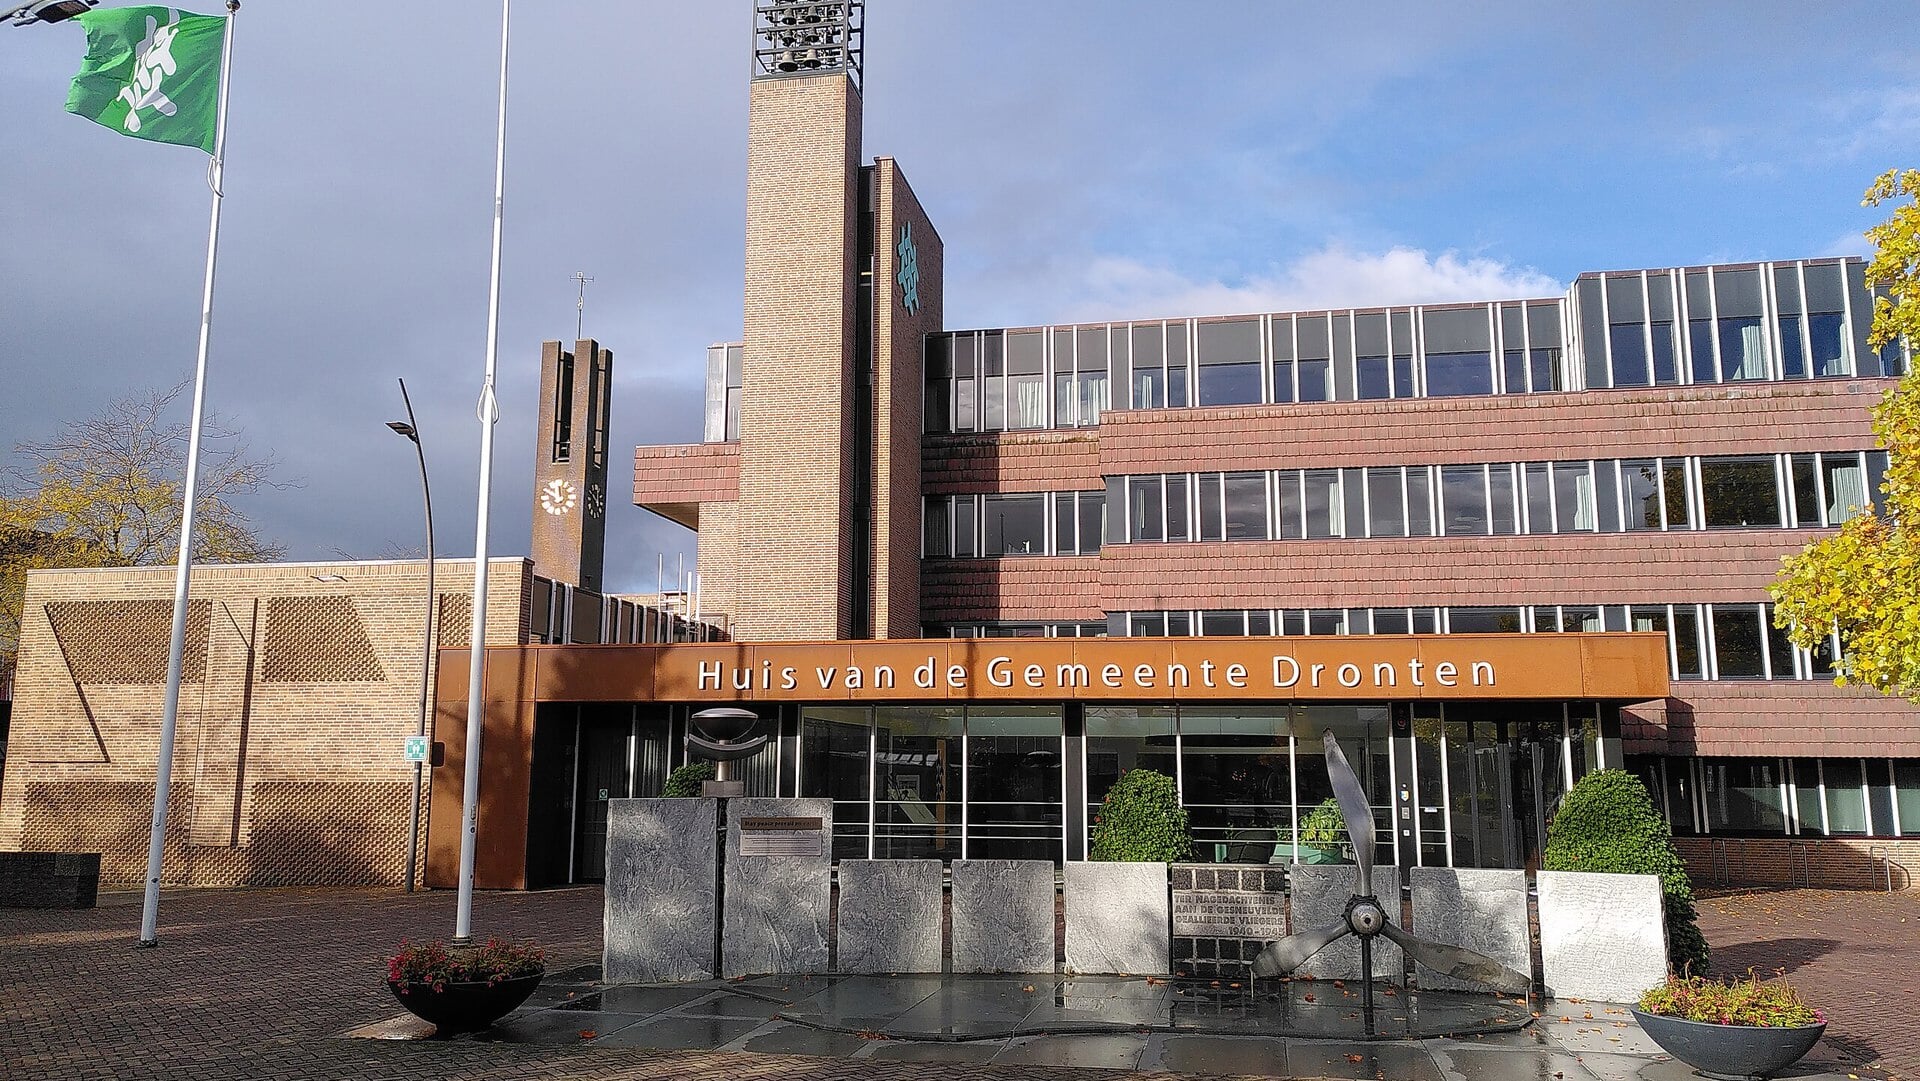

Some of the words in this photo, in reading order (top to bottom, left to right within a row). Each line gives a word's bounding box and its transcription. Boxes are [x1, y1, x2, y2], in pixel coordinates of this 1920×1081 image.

[697, 660, 797, 690] Huis
[815, 665, 895, 690] van
[912, 656, 966, 689] de
[985, 656, 1249, 689] Gemeente
[1272, 655, 1496, 687] Dronten
[1175, 895, 1192, 904] TER
[1195, 895, 1275, 905] NAGEDACHTENIS
[1175, 905, 1197, 914] AAN
[1200, 905, 1214, 914] DE
[1216, 906, 1285, 916] GESNEUVELDE
[1238, 916, 1284, 926] VLIEGERS
